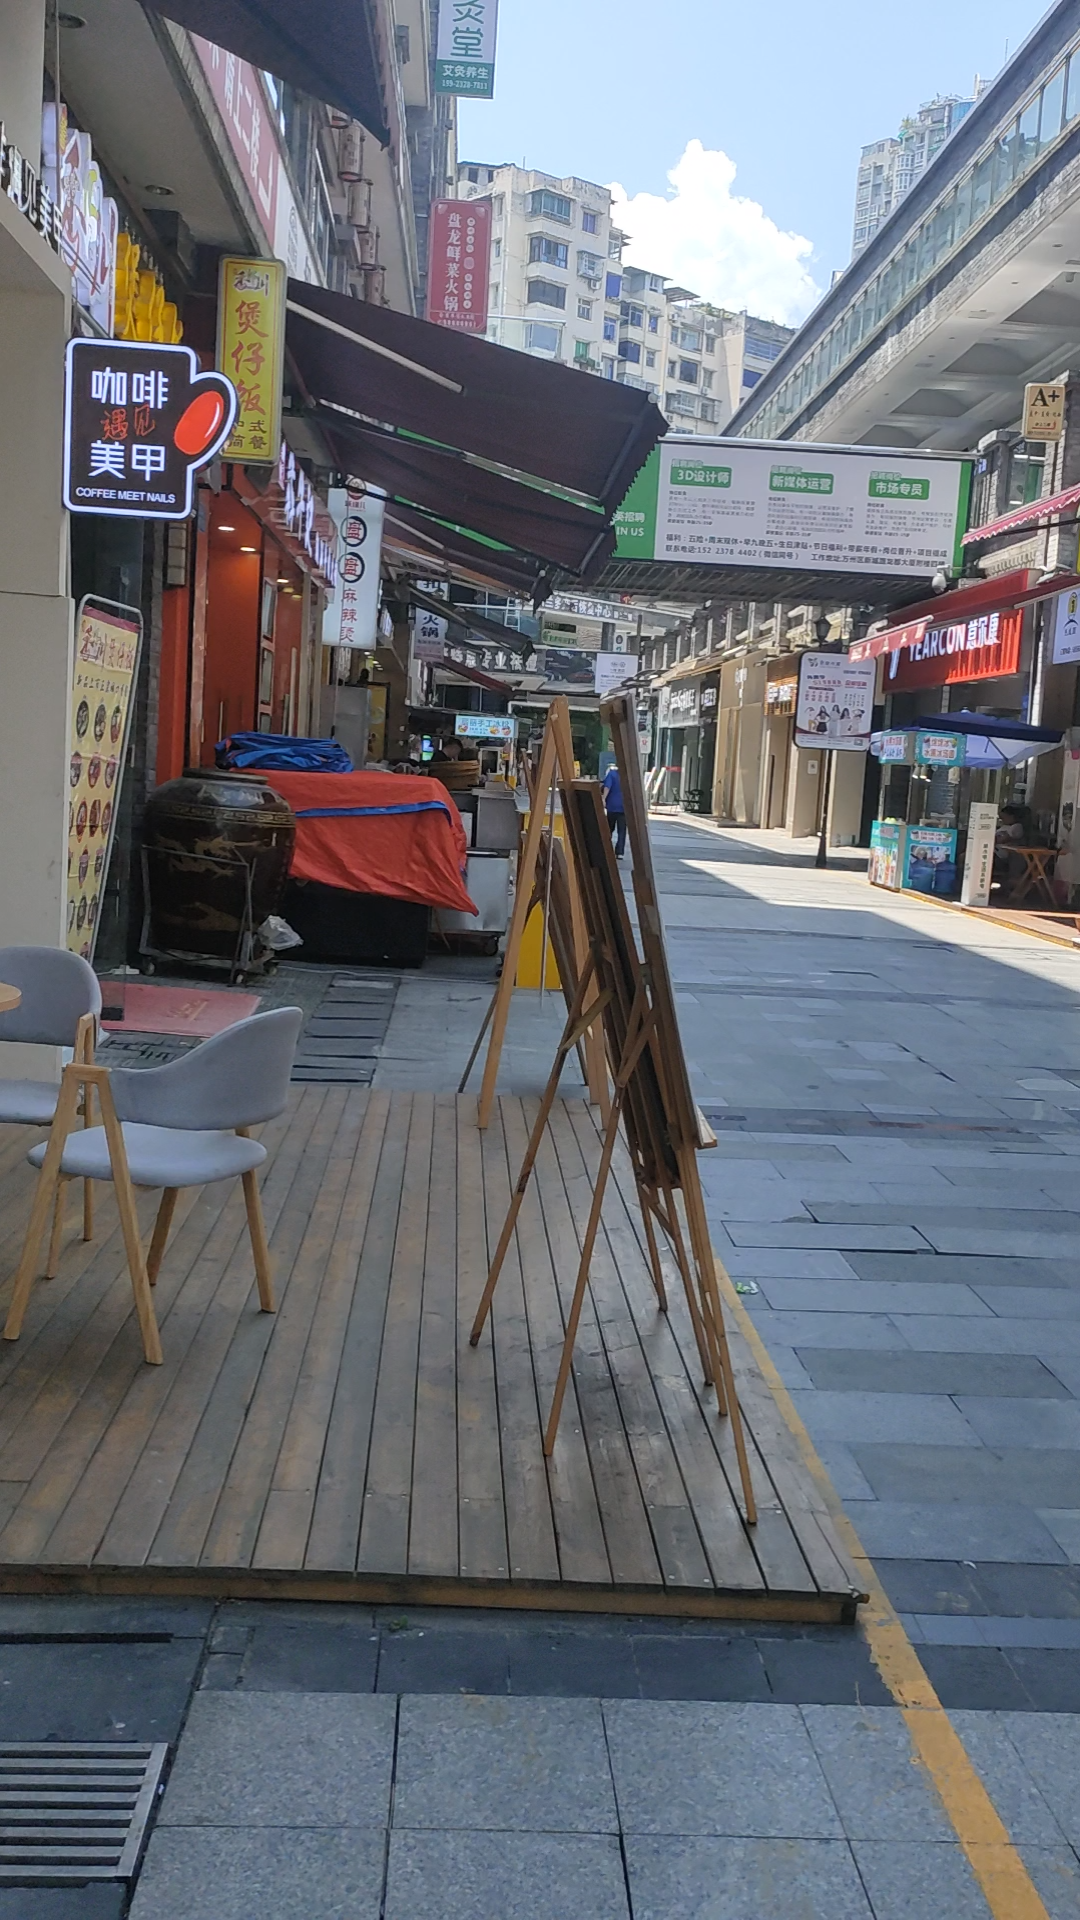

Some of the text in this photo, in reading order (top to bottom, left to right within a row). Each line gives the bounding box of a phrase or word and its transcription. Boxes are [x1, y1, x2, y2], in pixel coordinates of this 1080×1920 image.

[442, 65, 489, 79] 艾灸养生
[444, 212, 462, 312] 盘龙鲜菜火锅
[231, 300, 269, 415] 煲仔饭
[91, 366, 169, 409] 咖啡
[1030, 388, 1061, 407] A+
[100, 403, 156, 441] 遇见
[88, 440, 166, 482] 美甲
[677, 469, 730, 485] 3D设计师
[771, 475, 832, 492] 新媒体运营
[76, 486, 176, 505] COFFEE MEET NAILS
[874, 481, 923, 497] 市场专员
[616, 526, 645, 537] IN US
[420, 614, 440, 639] 火锅
[909, 623, 967, 662] YEARCON
